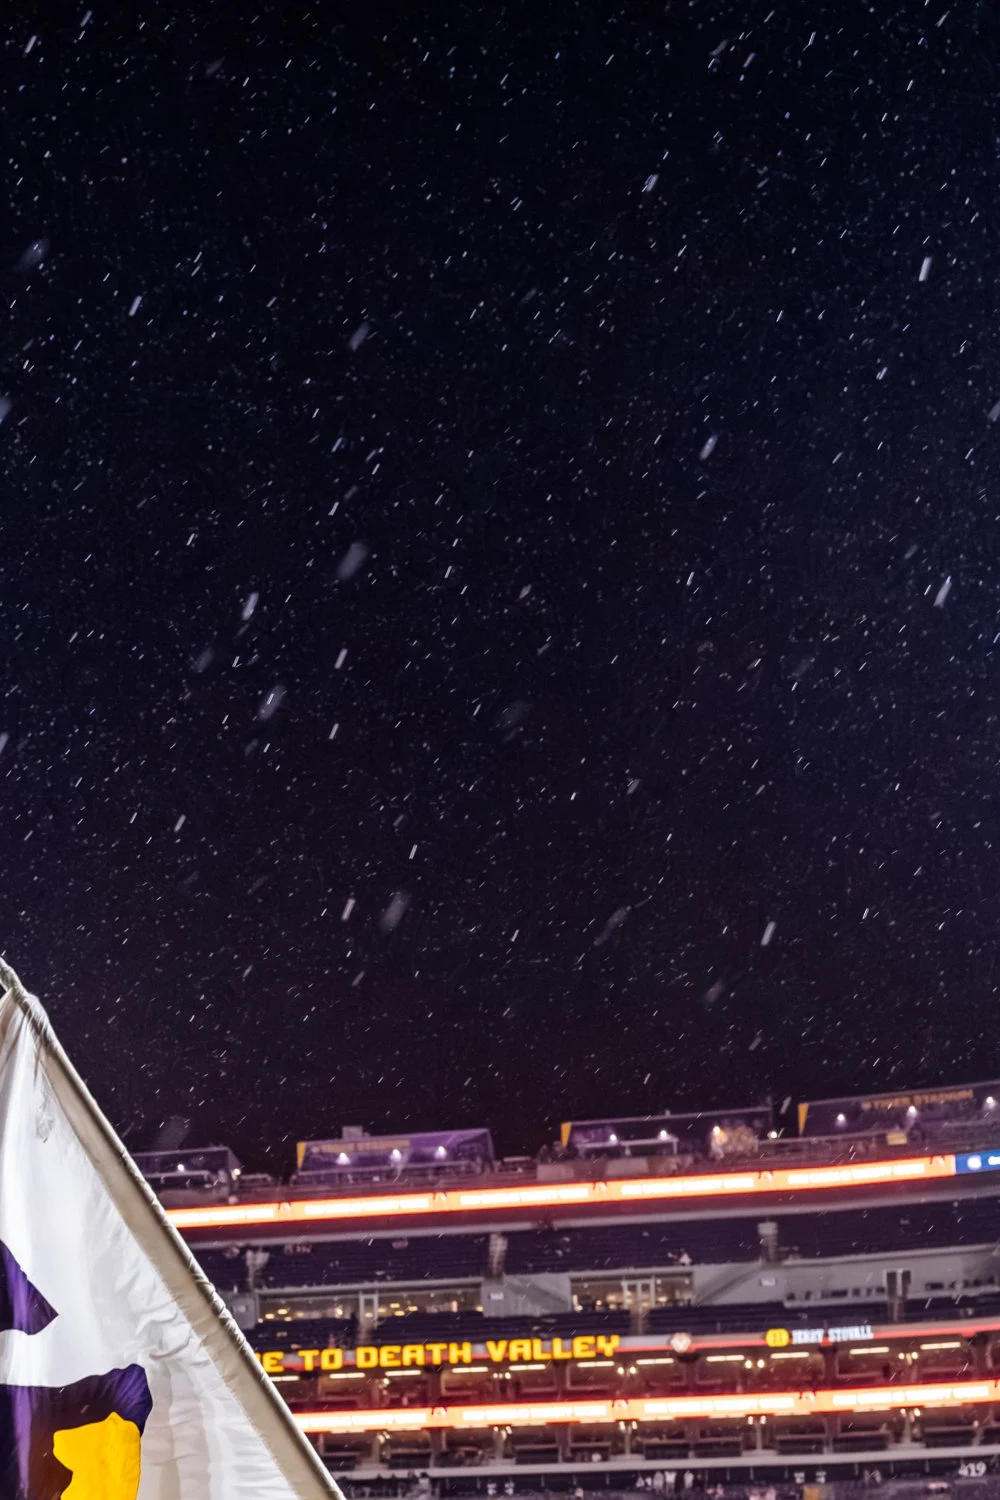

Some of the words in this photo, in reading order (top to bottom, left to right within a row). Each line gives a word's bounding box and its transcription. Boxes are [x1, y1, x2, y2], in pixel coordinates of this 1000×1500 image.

[256, 1351, 284, 1373] E
[298, 1349, 343, 1371] TO
[356, 1341, 473, 1368] DEATH
[486, 1334, 620, 1362] VALLEY
